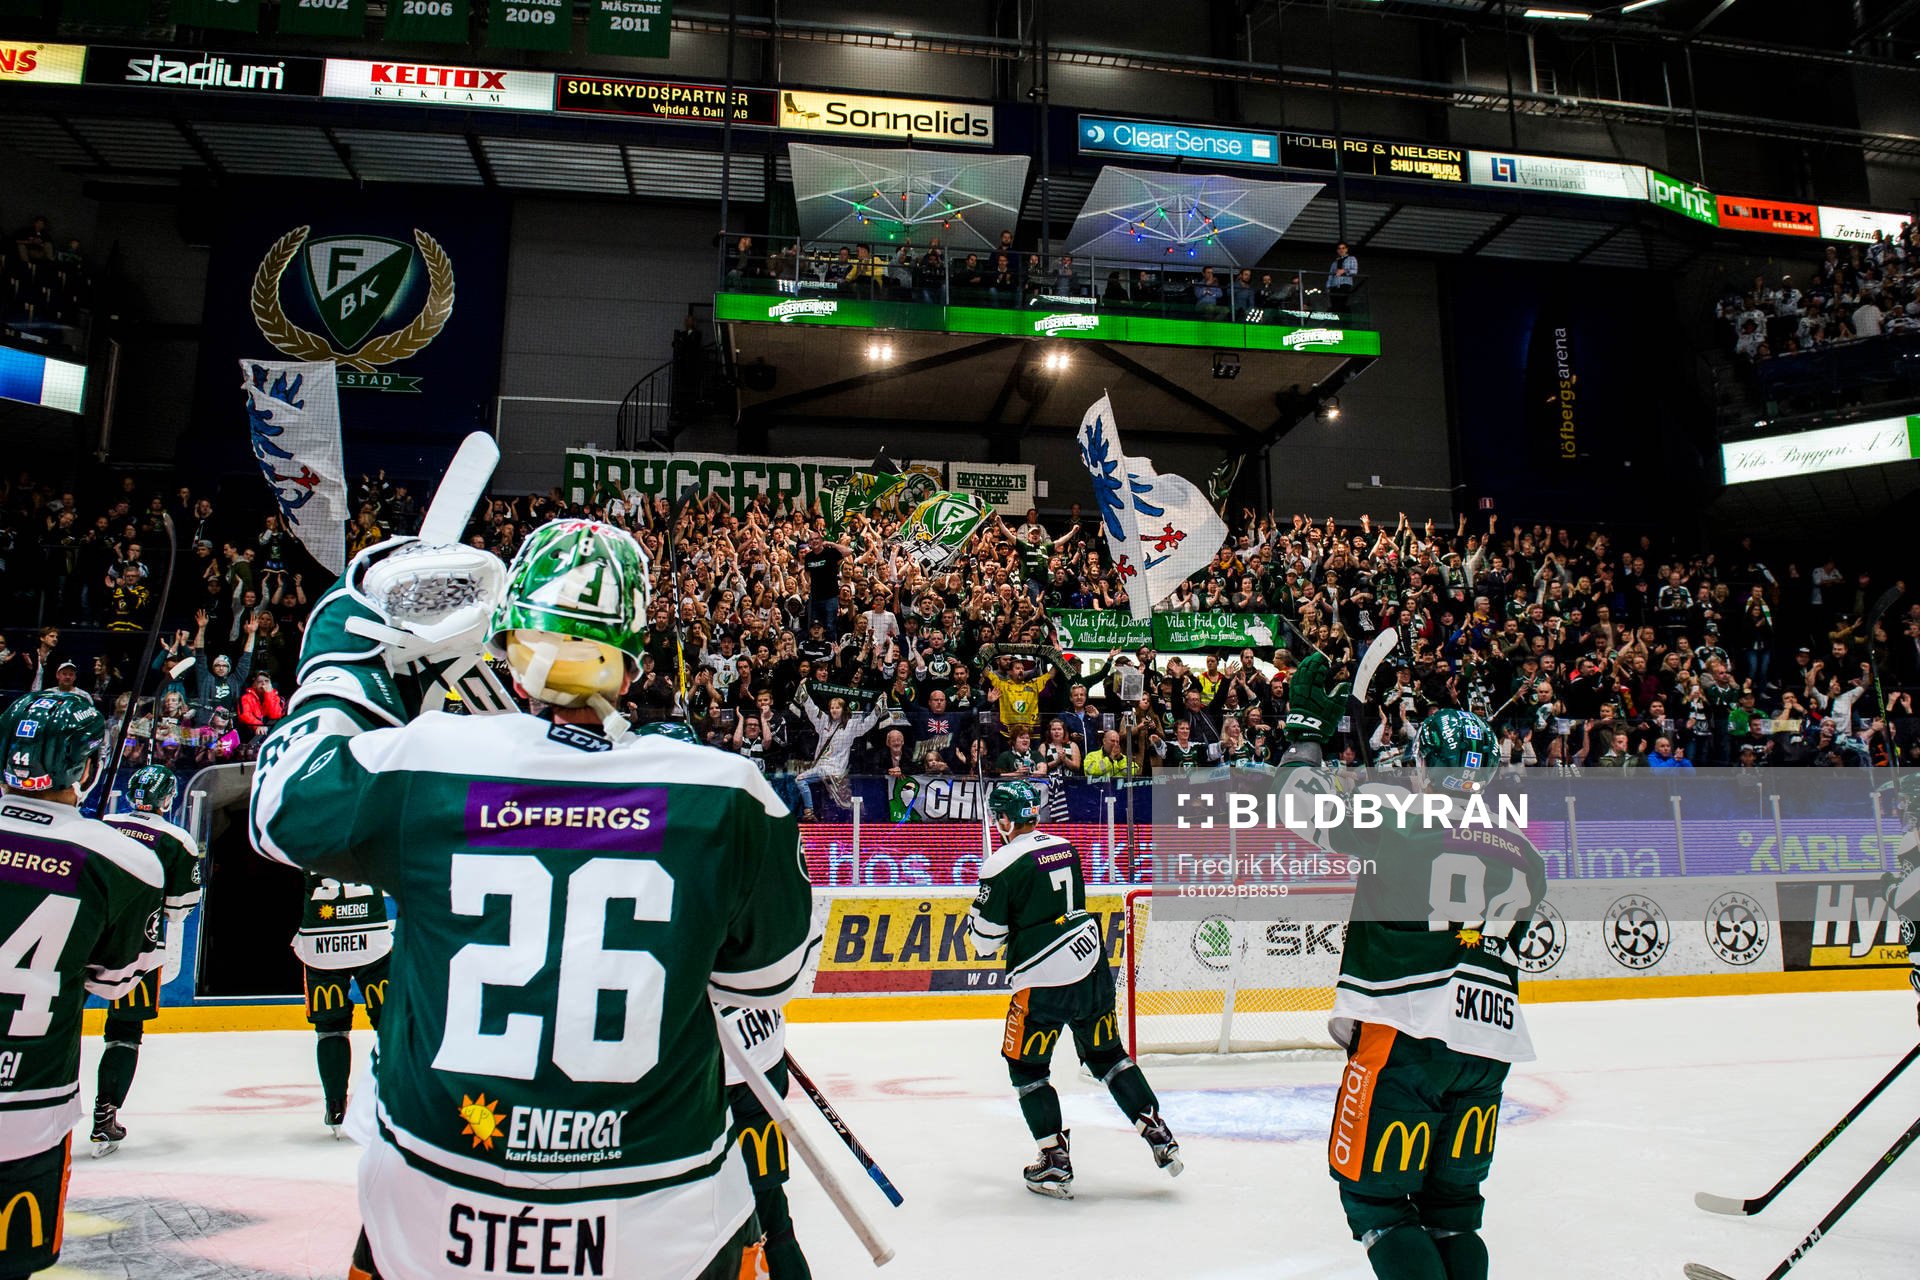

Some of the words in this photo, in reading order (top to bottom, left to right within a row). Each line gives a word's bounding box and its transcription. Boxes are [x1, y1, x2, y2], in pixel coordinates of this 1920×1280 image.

[402, 1, 453, 16] 2006
[505, 8, 556, 25] 2009
[601, 2, 661, 14] MÄSTARE
[610, 16, 650, 33] 2011
[125, 54, 285, 90] stadium
[371, 64, 507, 90] KELTOX
[653, 103, 689, 116] Vendel
[692, 105, 700, 116] &
[733, 109, 748, 120] AB
[826, 102, 989, 137] Sonnelids
[1287, 135, 1368, 152] HOLBRG
[1373, 144, 1386, 154] &
[1391, 145, 1461, 162] NIELSEN
[1391, 159, 1413, 173] SHU
[1415, 162, 1462, 176] UEMURA
[1655, 179, 1711, 217] print
[336, 374, 393, 386] LSTAD
[563, 453, 875, 518] BRYGGERI
[1068, 613, 1088, 627] Vila
[1092, 615, 1095, 627] i
[1093, 612, 1118, 631] frid,
[1165, 613, 1185, 628] Vila
[1188, 616, 1191, 627] i
[1192, 612, 1215, 631] frid,
[1078, 631, 1097, 643] Alltid
[1170, 631, 1189, 642] Alltid
[551, 725, 611, 751] CCM
[12, 751, 30, 766] 44
[2, 808, 52, 824] CCM
[480, 801, 651, 830] LÖFBERGS
[1037, 849, 1073, 865] LÖFBERGS
[1048, 866, 1074, 912] 7
[336, 903, 369, 916] ENERGI
[316, 934, 368, 954] NYGREN
[1610, 940, 1666, 966] TEKNIK
[1712, 937, 1765, 962] TEKNIK
[431, 853, 675, 1083] 26
[1456, 984, 1515, 1030] SKOGS
[736, 1007, 782, 1051] JÄM
[1334, 1058, 1368, 1165] armat
[507, 1106, 629, 1151] ENERGI
[505, 1147, 623, 1164] karlstadsenergi.se
[446, 1203, 607, 1277] STÉEN
